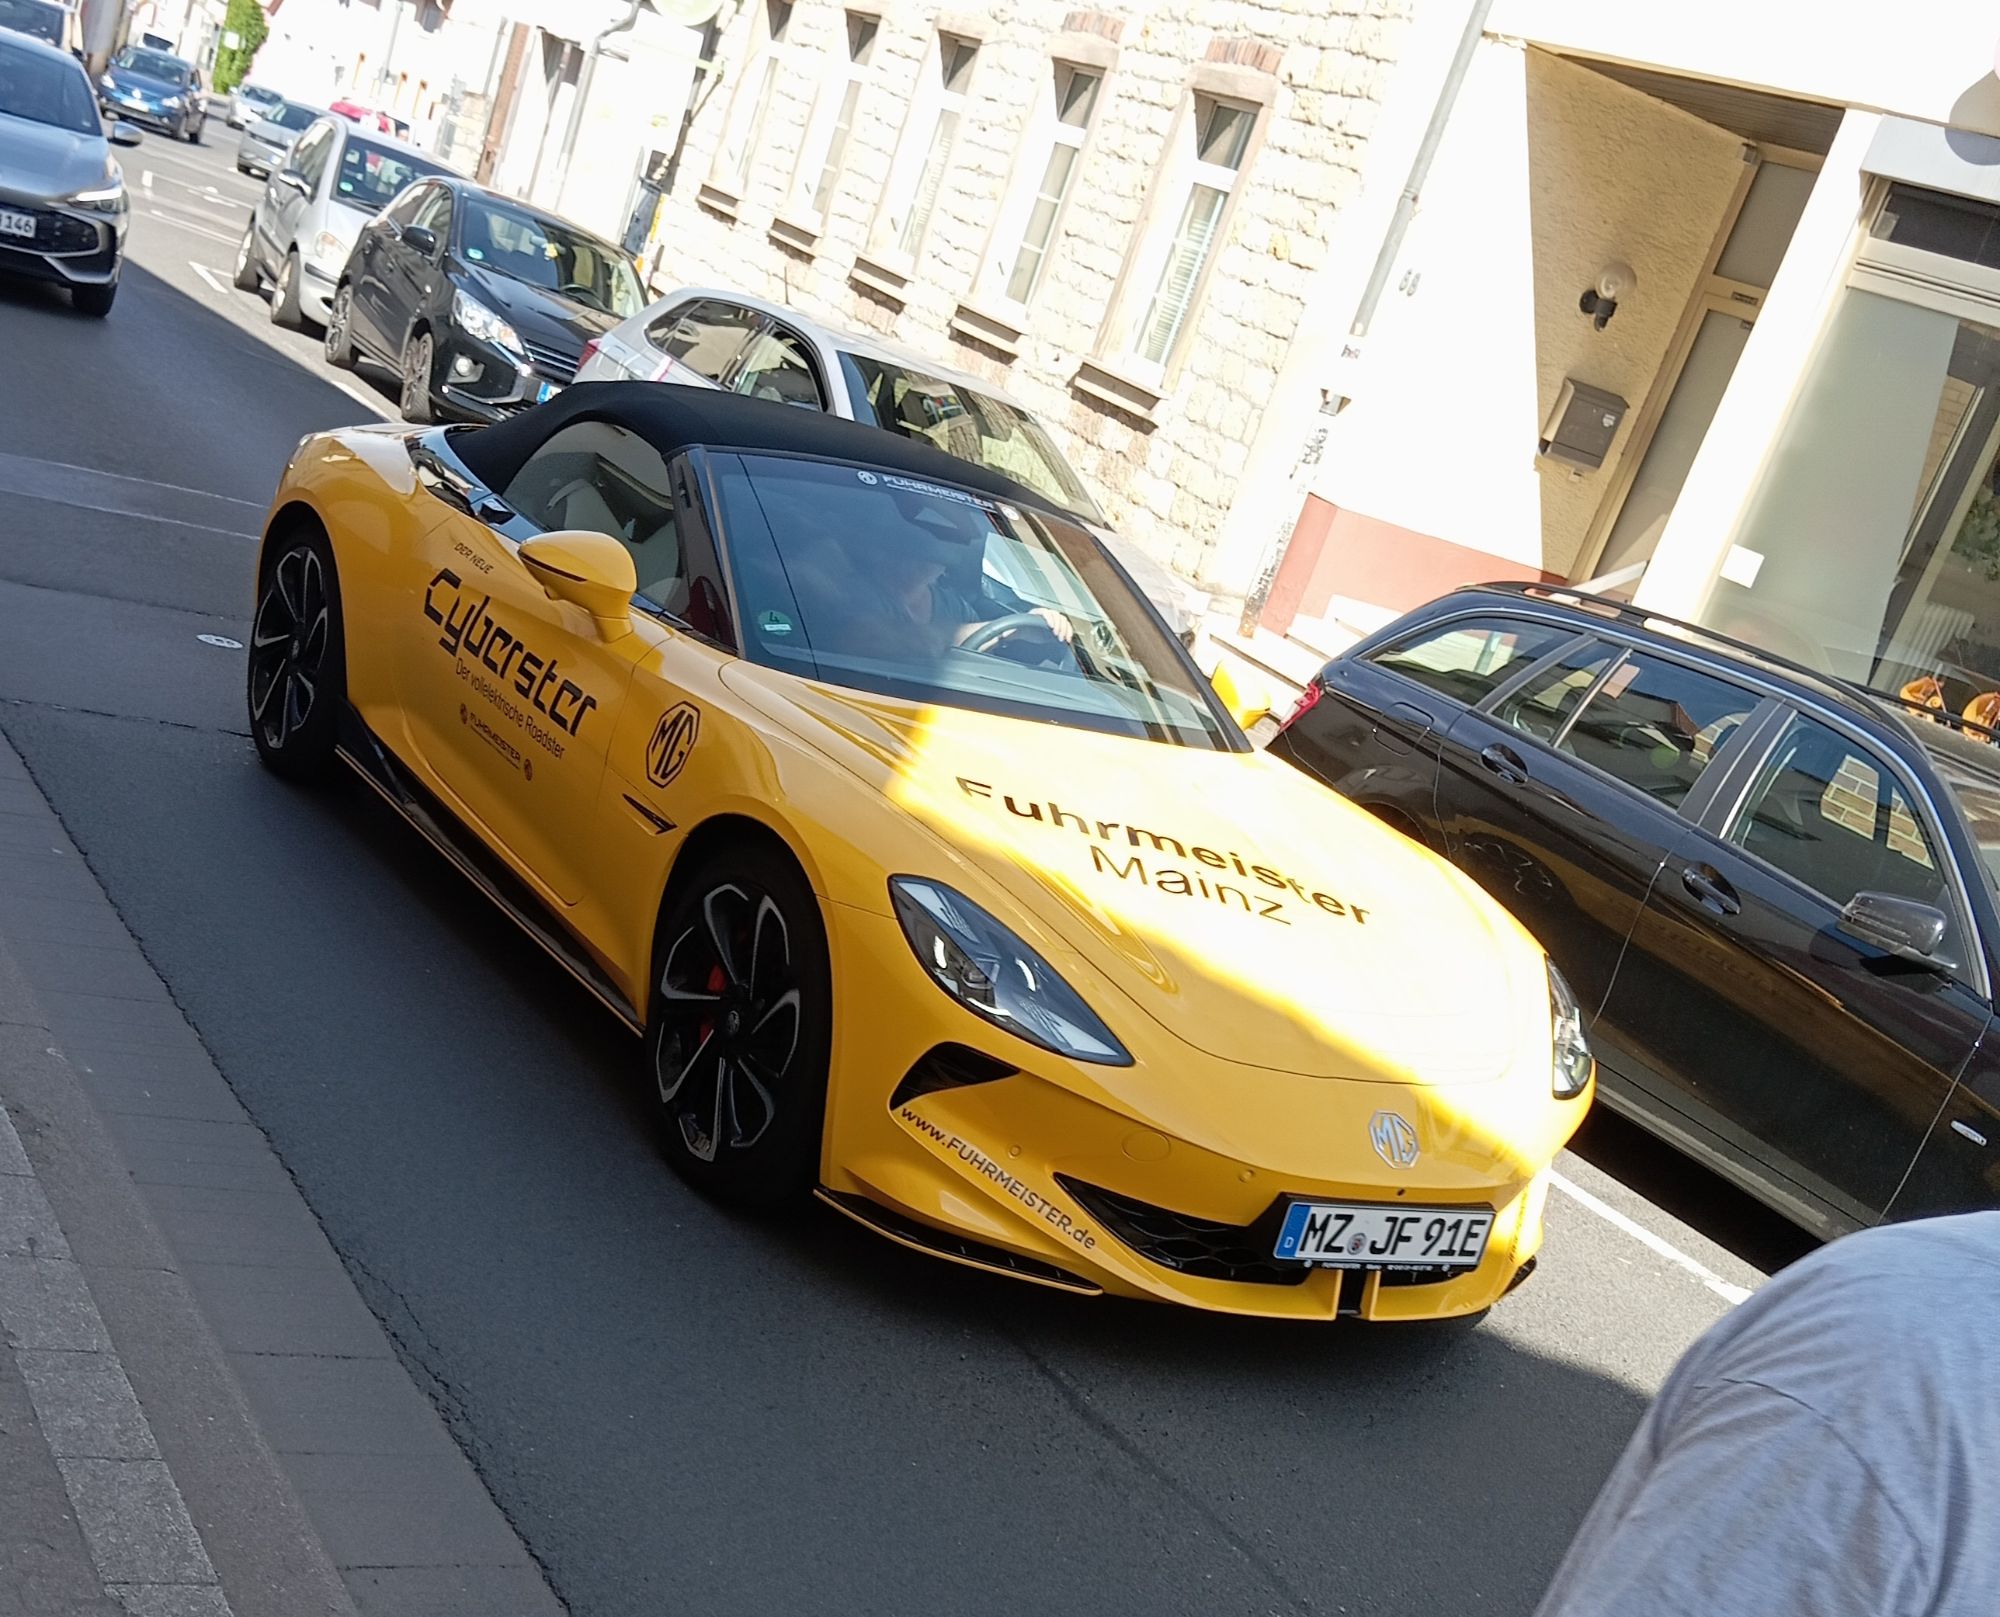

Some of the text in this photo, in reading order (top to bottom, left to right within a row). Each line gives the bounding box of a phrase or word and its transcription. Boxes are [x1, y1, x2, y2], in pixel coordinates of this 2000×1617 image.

[4, 214, 33, 233] 146
[882, 475, 994, 509] FUHRMEISTER
[454, 542, 494, 574] DER NEUE
[769, 611, 780, 623] 4
[424, 568, 597, 737] Cyberster
[456, 658, 470, 681] Der
[471, 674, 524, 727] vollelektrische
[525, 715, 566, 759] Roadster
[470, 712, 520, 760] FUHRMEISTER
[650, 708, 693, 780] MG
[955, 776, 1371, 925] Fuhrmeister
[1089, 844, 1292, 926] Mainz
[1372, 1114, 1418, 1164] MG
[901, 1107, 1096, 1250] www.FUHRMEISTER.de
[1284, 1213, 1488, 1257] D MZ JF 91E
